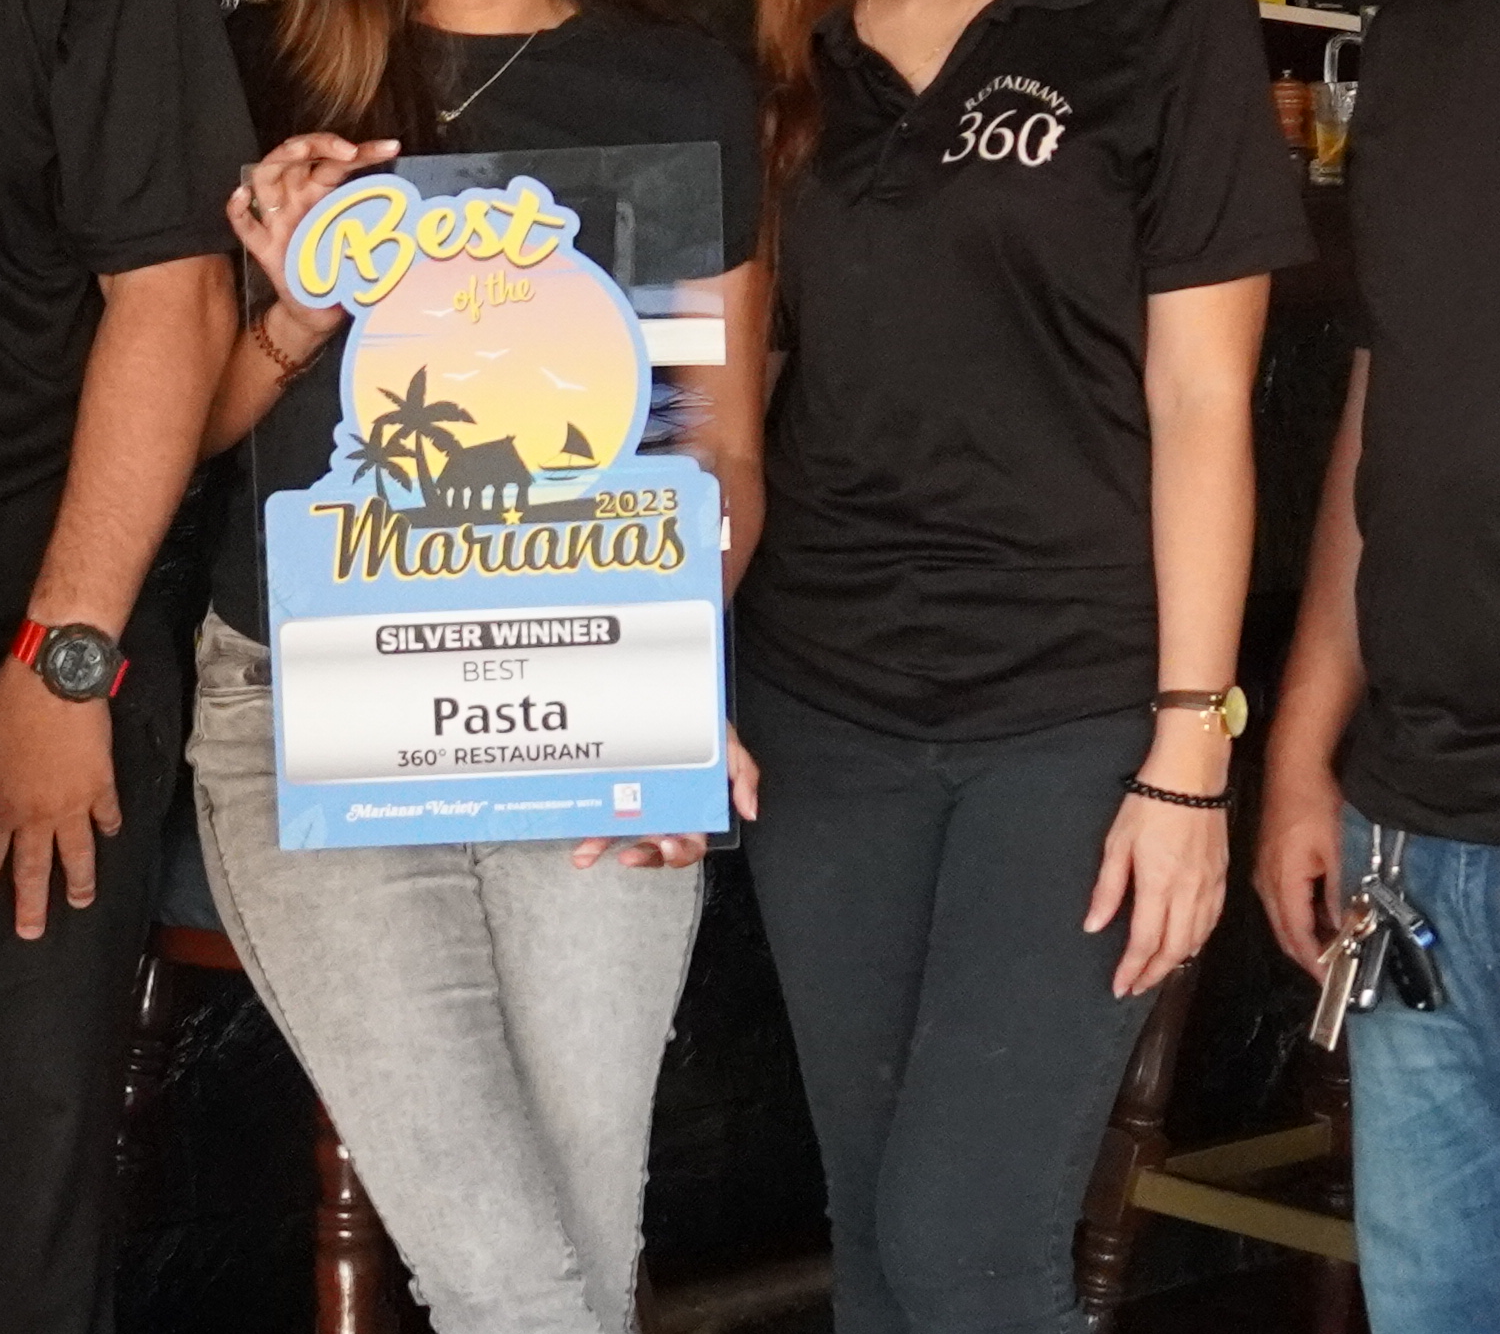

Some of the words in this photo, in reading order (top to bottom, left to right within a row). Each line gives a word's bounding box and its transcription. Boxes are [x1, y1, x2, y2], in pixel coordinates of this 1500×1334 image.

[963, 74, 1074, 117] RESTAURANT
[941, 109, 1066, 167] 360
[299, 185, 566, 307] Best
[453, 275, 483, 324] of
[485, 269, 536, 305] the
[596, 487, 680, 518] 2023
[309, 494, 688, 585] Marianas
[378, 622, 482, 653] SILVER
[490, 617, 612, 648] WINNER
[462, 659, 530, 682] BEST
[432, 694, 569, 737] Pasta
[397, 747, 448, 768] 360°
[454, 741, 604, 766] RESTAURANT
[345, 802, 424, 823] Marianas
[424, 799, 489, 818] Variety
